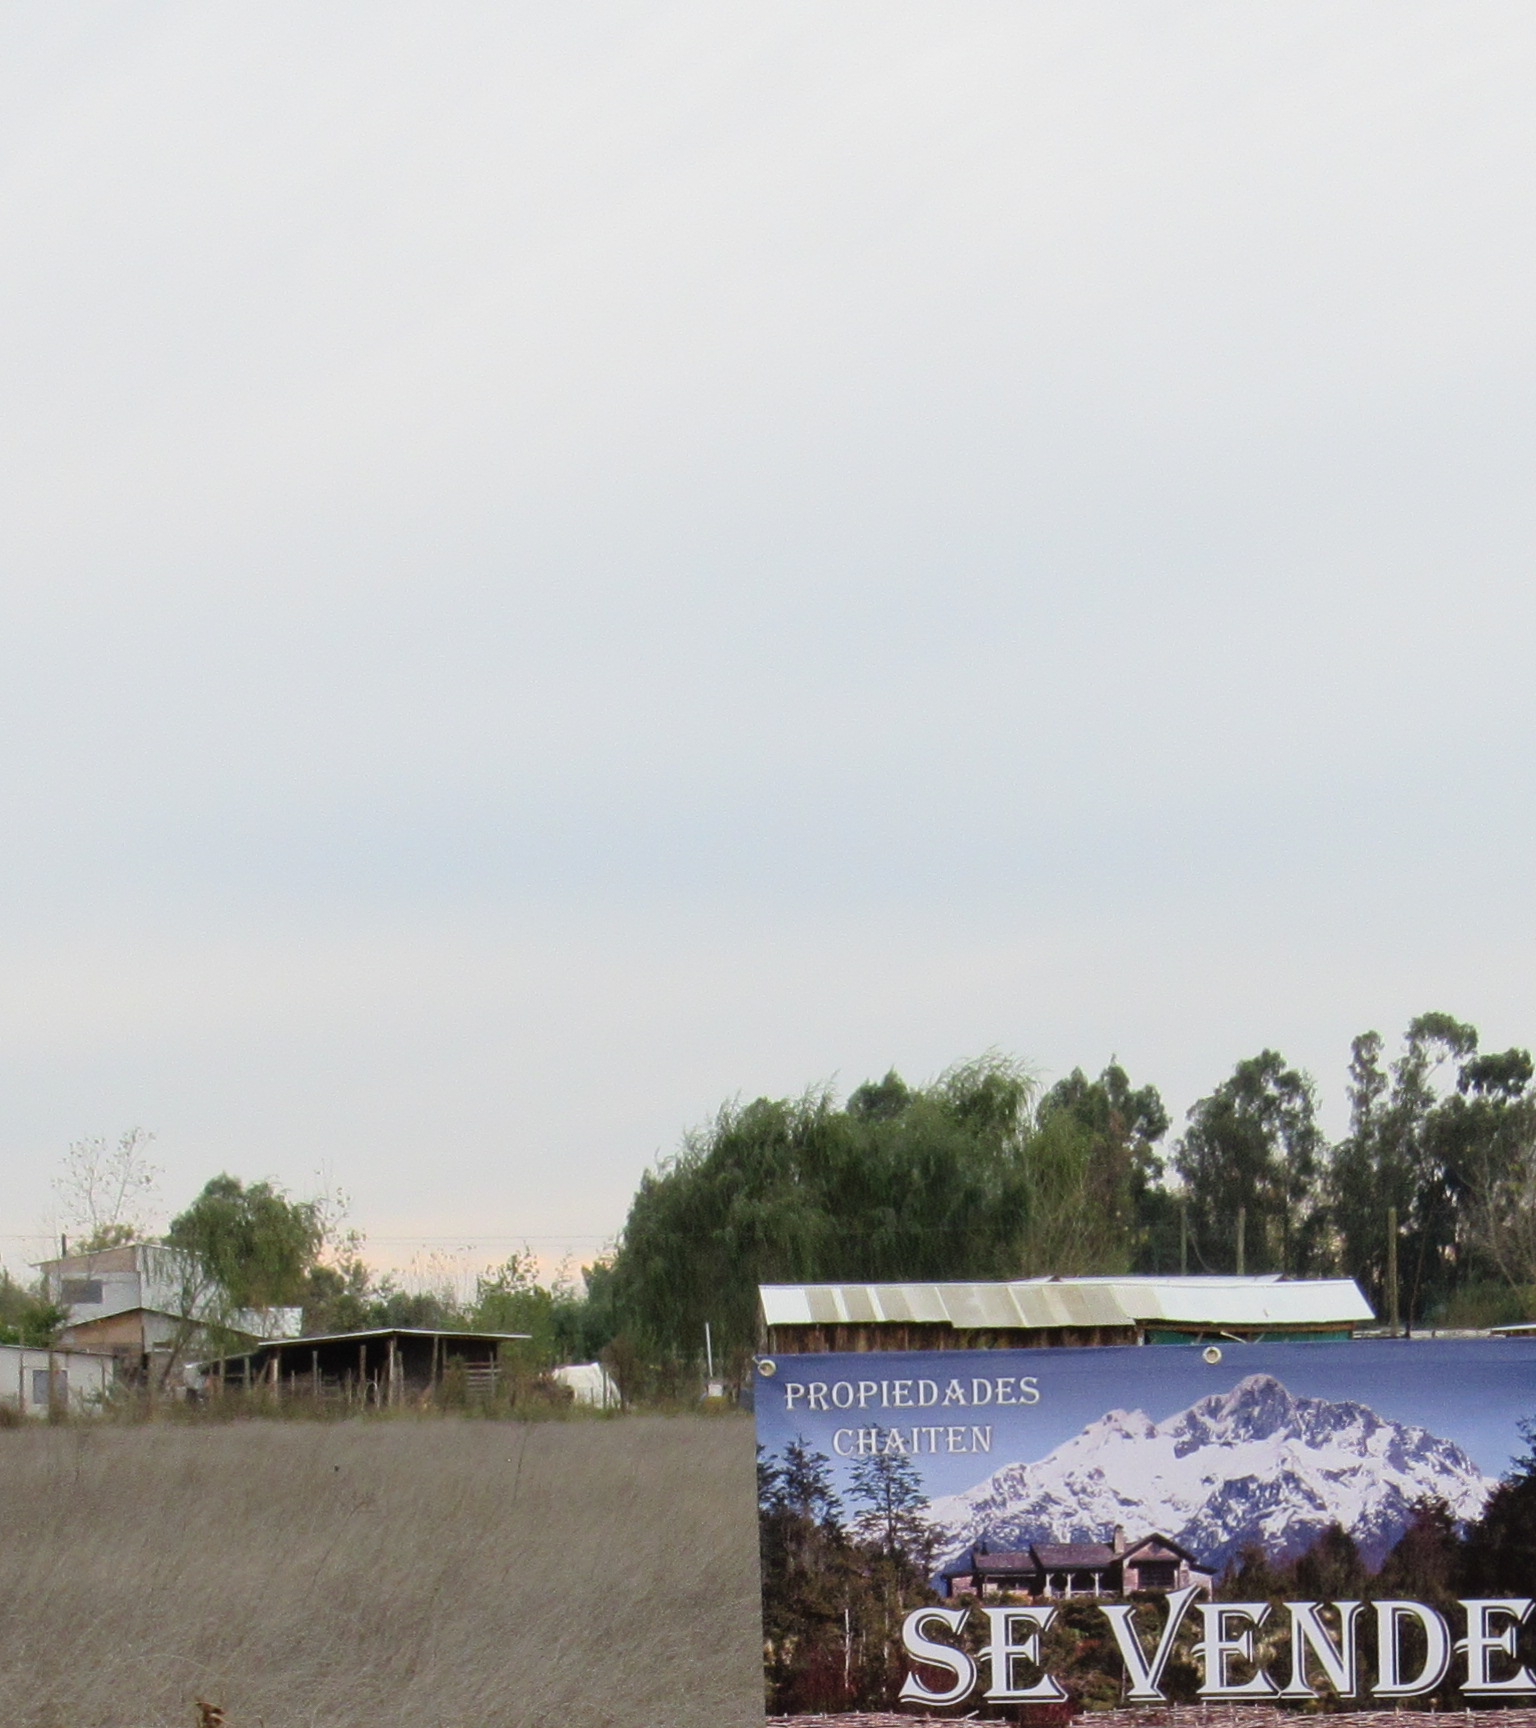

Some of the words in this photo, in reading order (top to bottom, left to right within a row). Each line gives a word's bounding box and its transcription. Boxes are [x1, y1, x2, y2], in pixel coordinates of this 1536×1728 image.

[783, 1377, 1041, 1410] PROPIEDADES
[832, 1426, 993, 1456] CHAITEN
[898, 1606, 1068, 1705] SE
